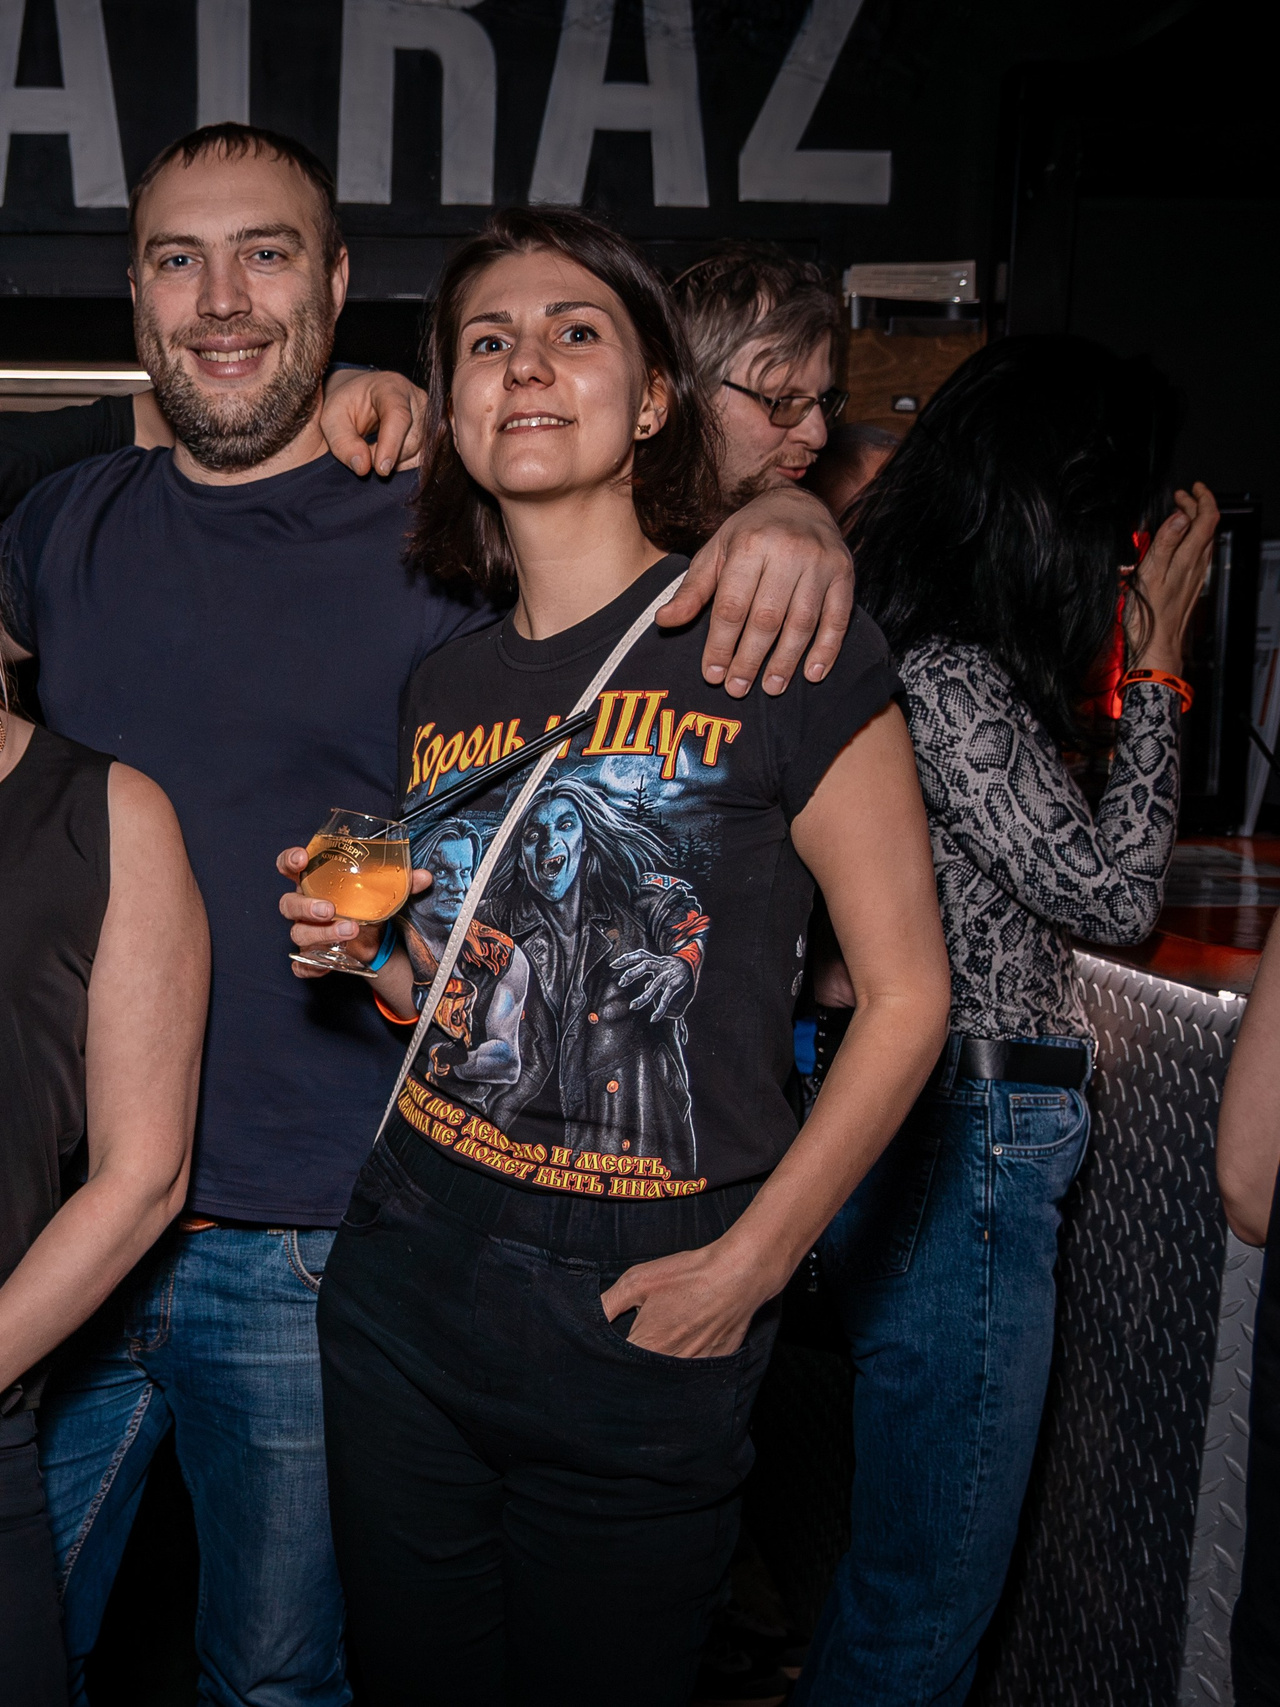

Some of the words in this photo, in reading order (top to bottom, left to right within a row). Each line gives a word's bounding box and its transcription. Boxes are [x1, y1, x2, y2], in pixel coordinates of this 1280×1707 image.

[454, 1137, 536, 1180] МОЖЕТ
[532, 1166, 604, 1195] БЫТЬ
[550, 1145, 572, 1167] И
